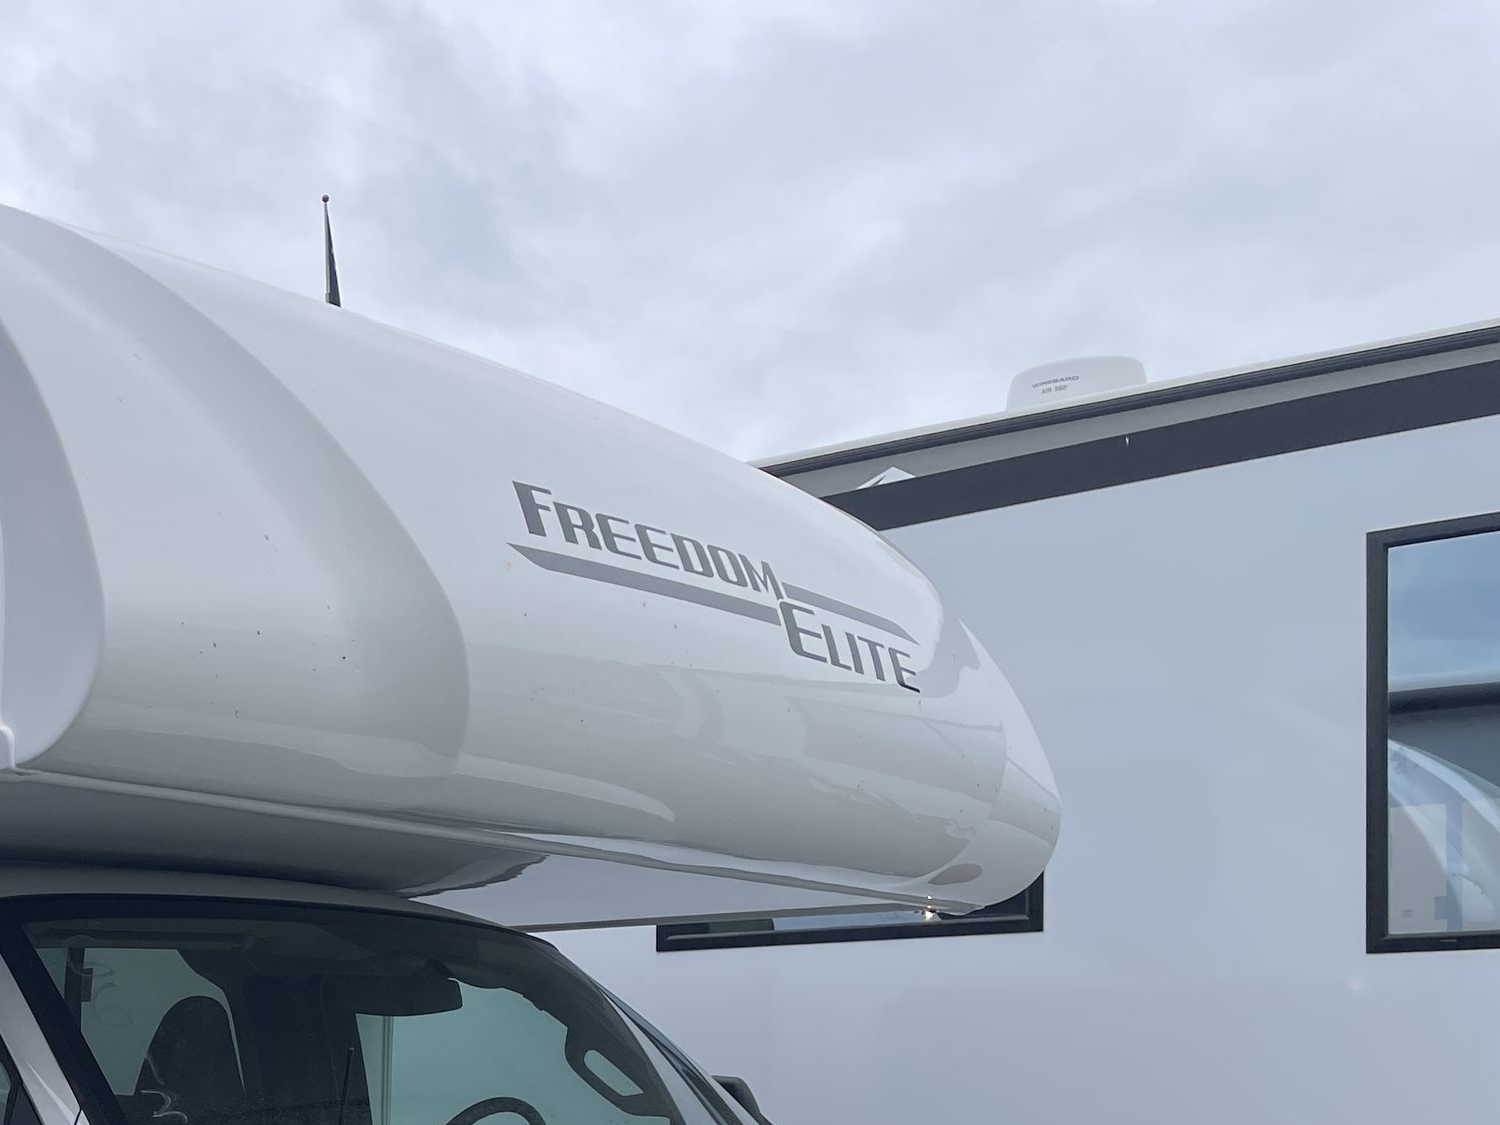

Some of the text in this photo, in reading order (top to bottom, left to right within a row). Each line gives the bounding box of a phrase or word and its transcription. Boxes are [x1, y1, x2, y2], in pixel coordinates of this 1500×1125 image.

[1032, 375, 1079, 388] WINEGARD
[512, 480, 784, 601] FREEDOM
[780, 600, 921, 694] ELITE
